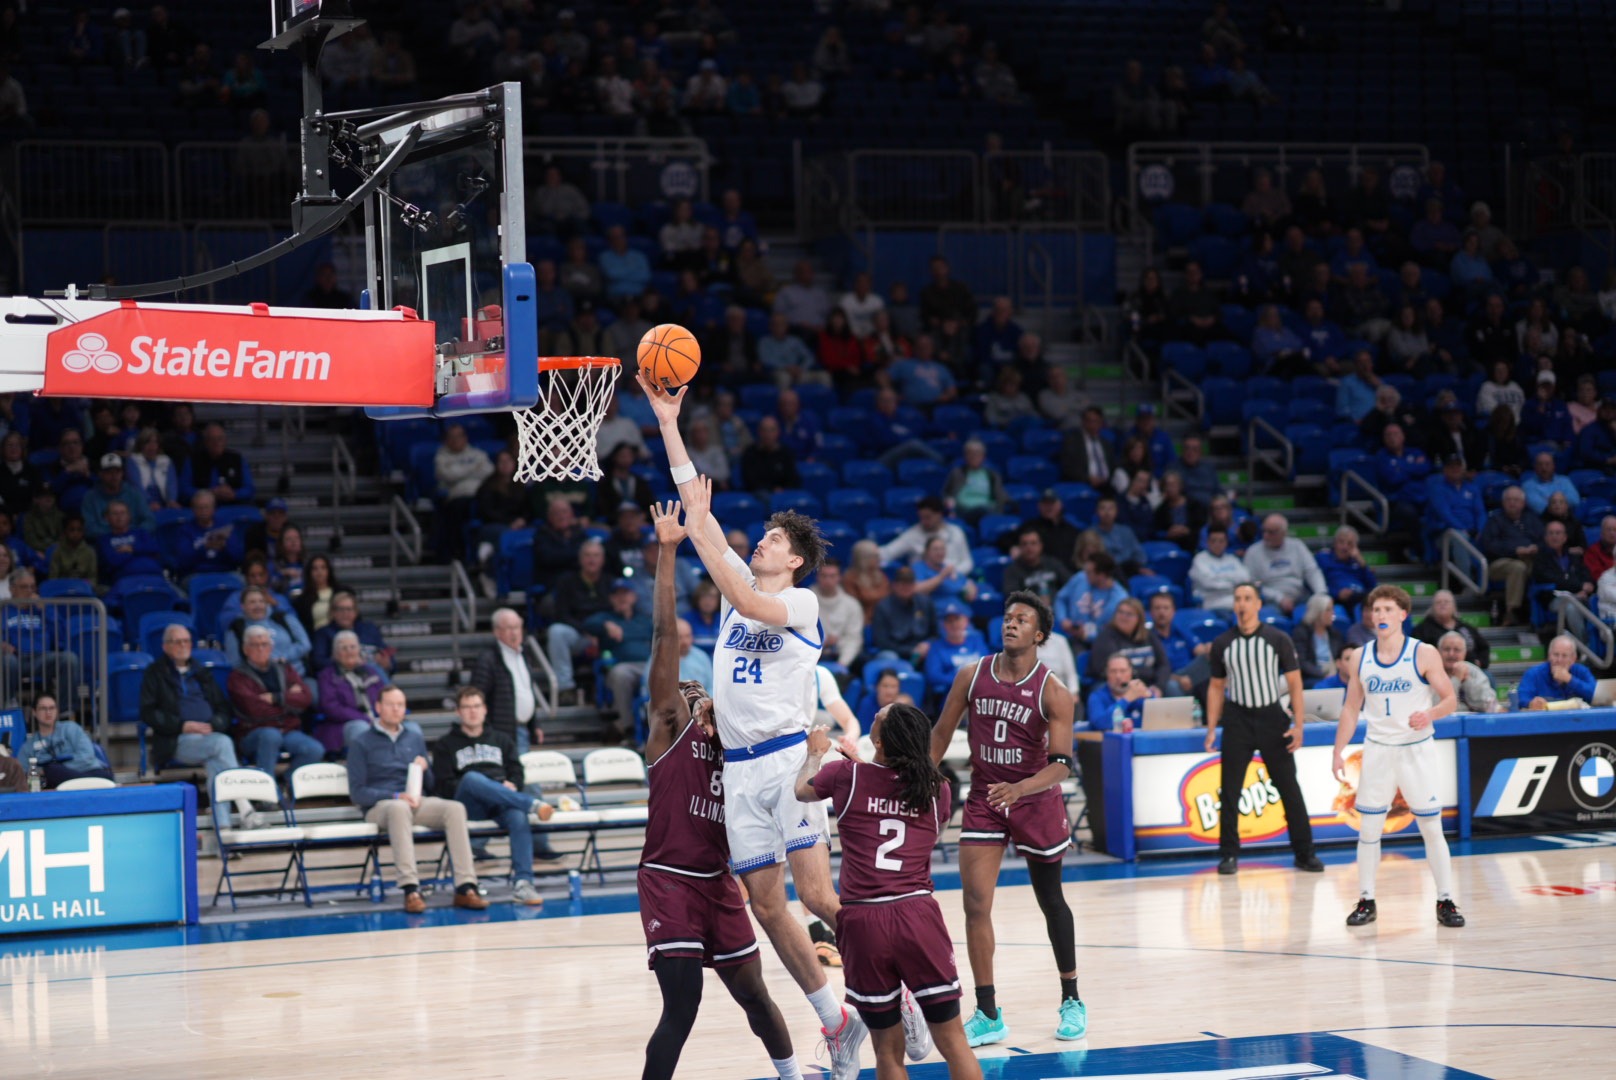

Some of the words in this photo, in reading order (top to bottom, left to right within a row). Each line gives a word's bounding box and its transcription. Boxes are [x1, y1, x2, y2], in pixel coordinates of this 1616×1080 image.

[723, 623, 783, 652] Drake
[733, 656, 762, 684] 24
[1366, 674, 1412, 694] Drake
[975, 698, 1032, 724] SOUTHERN
[1385, 697, 1391, 716] 1
[994, 720, 1007, 743] 0
[980, 744, 1022, 764] ILLINOIS
[710, 771, 722, 796] 8
[875, 818, 906, 872] 2
[52, 898, 106, 919] HAIL
